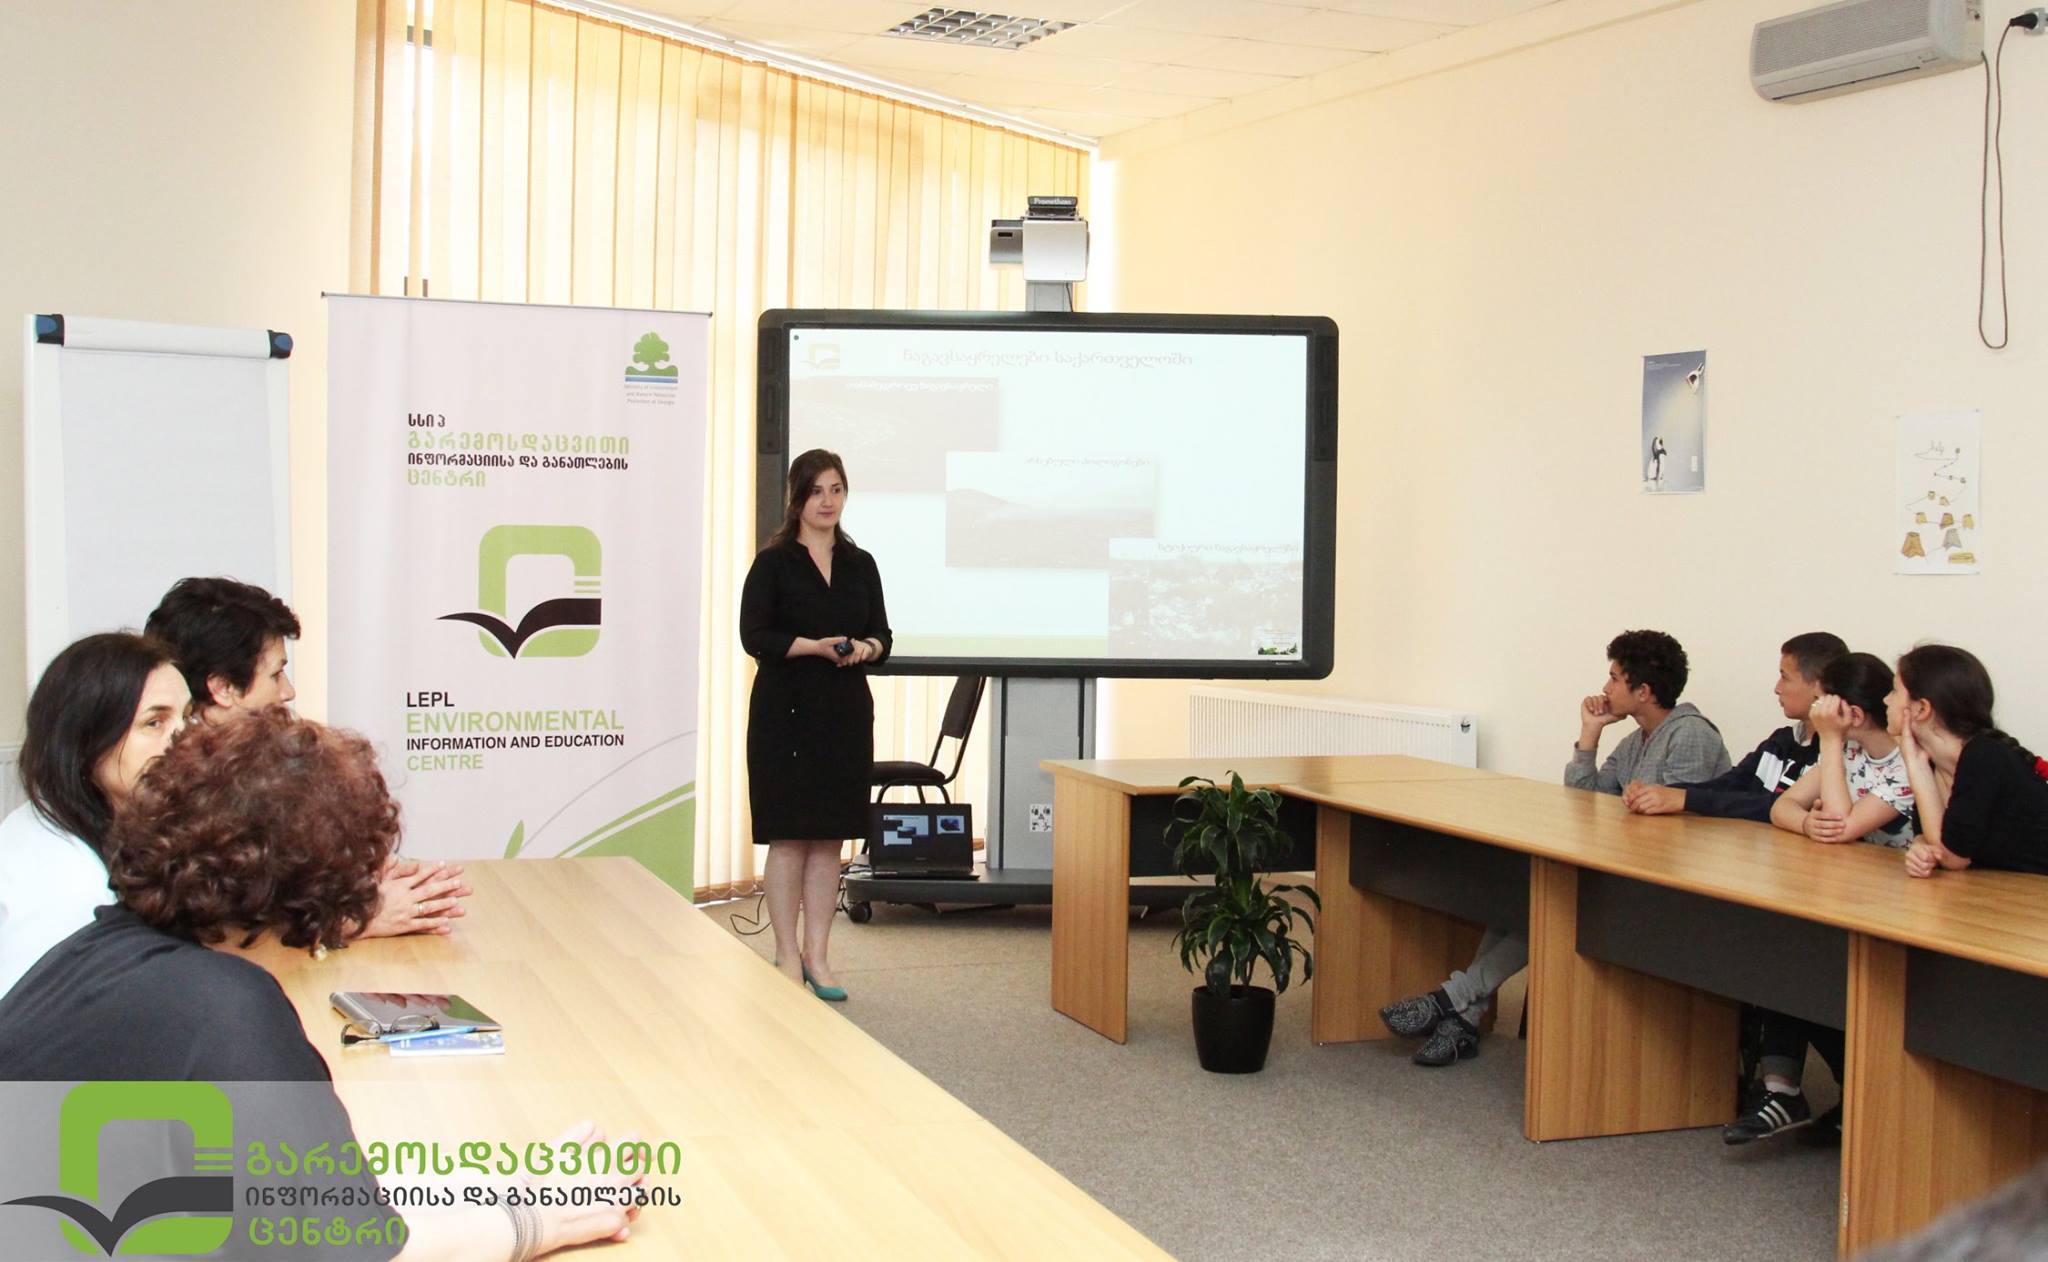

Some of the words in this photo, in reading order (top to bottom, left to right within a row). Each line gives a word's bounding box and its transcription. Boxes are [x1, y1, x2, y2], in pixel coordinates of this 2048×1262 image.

[408, 431, 630, 454] გარემოსდაცვითი
[408, 452, 515, 467] ინფორმაციისა
[519, 455, 538, 467] და
[542, 456, 629, 470] განათლების
[408, 468, 486, 487] ცენტრი
[406, 691, 455, 708] LEPL
[406, 709, 624, 734] ENVIRONMENTAL
[406, 736, 507, 751] INFORMATION
[510, 736, 541, 749] AND
[544, 734, 625, 748] EDUCATION
[406, 753, 484, 772] CENTRE
